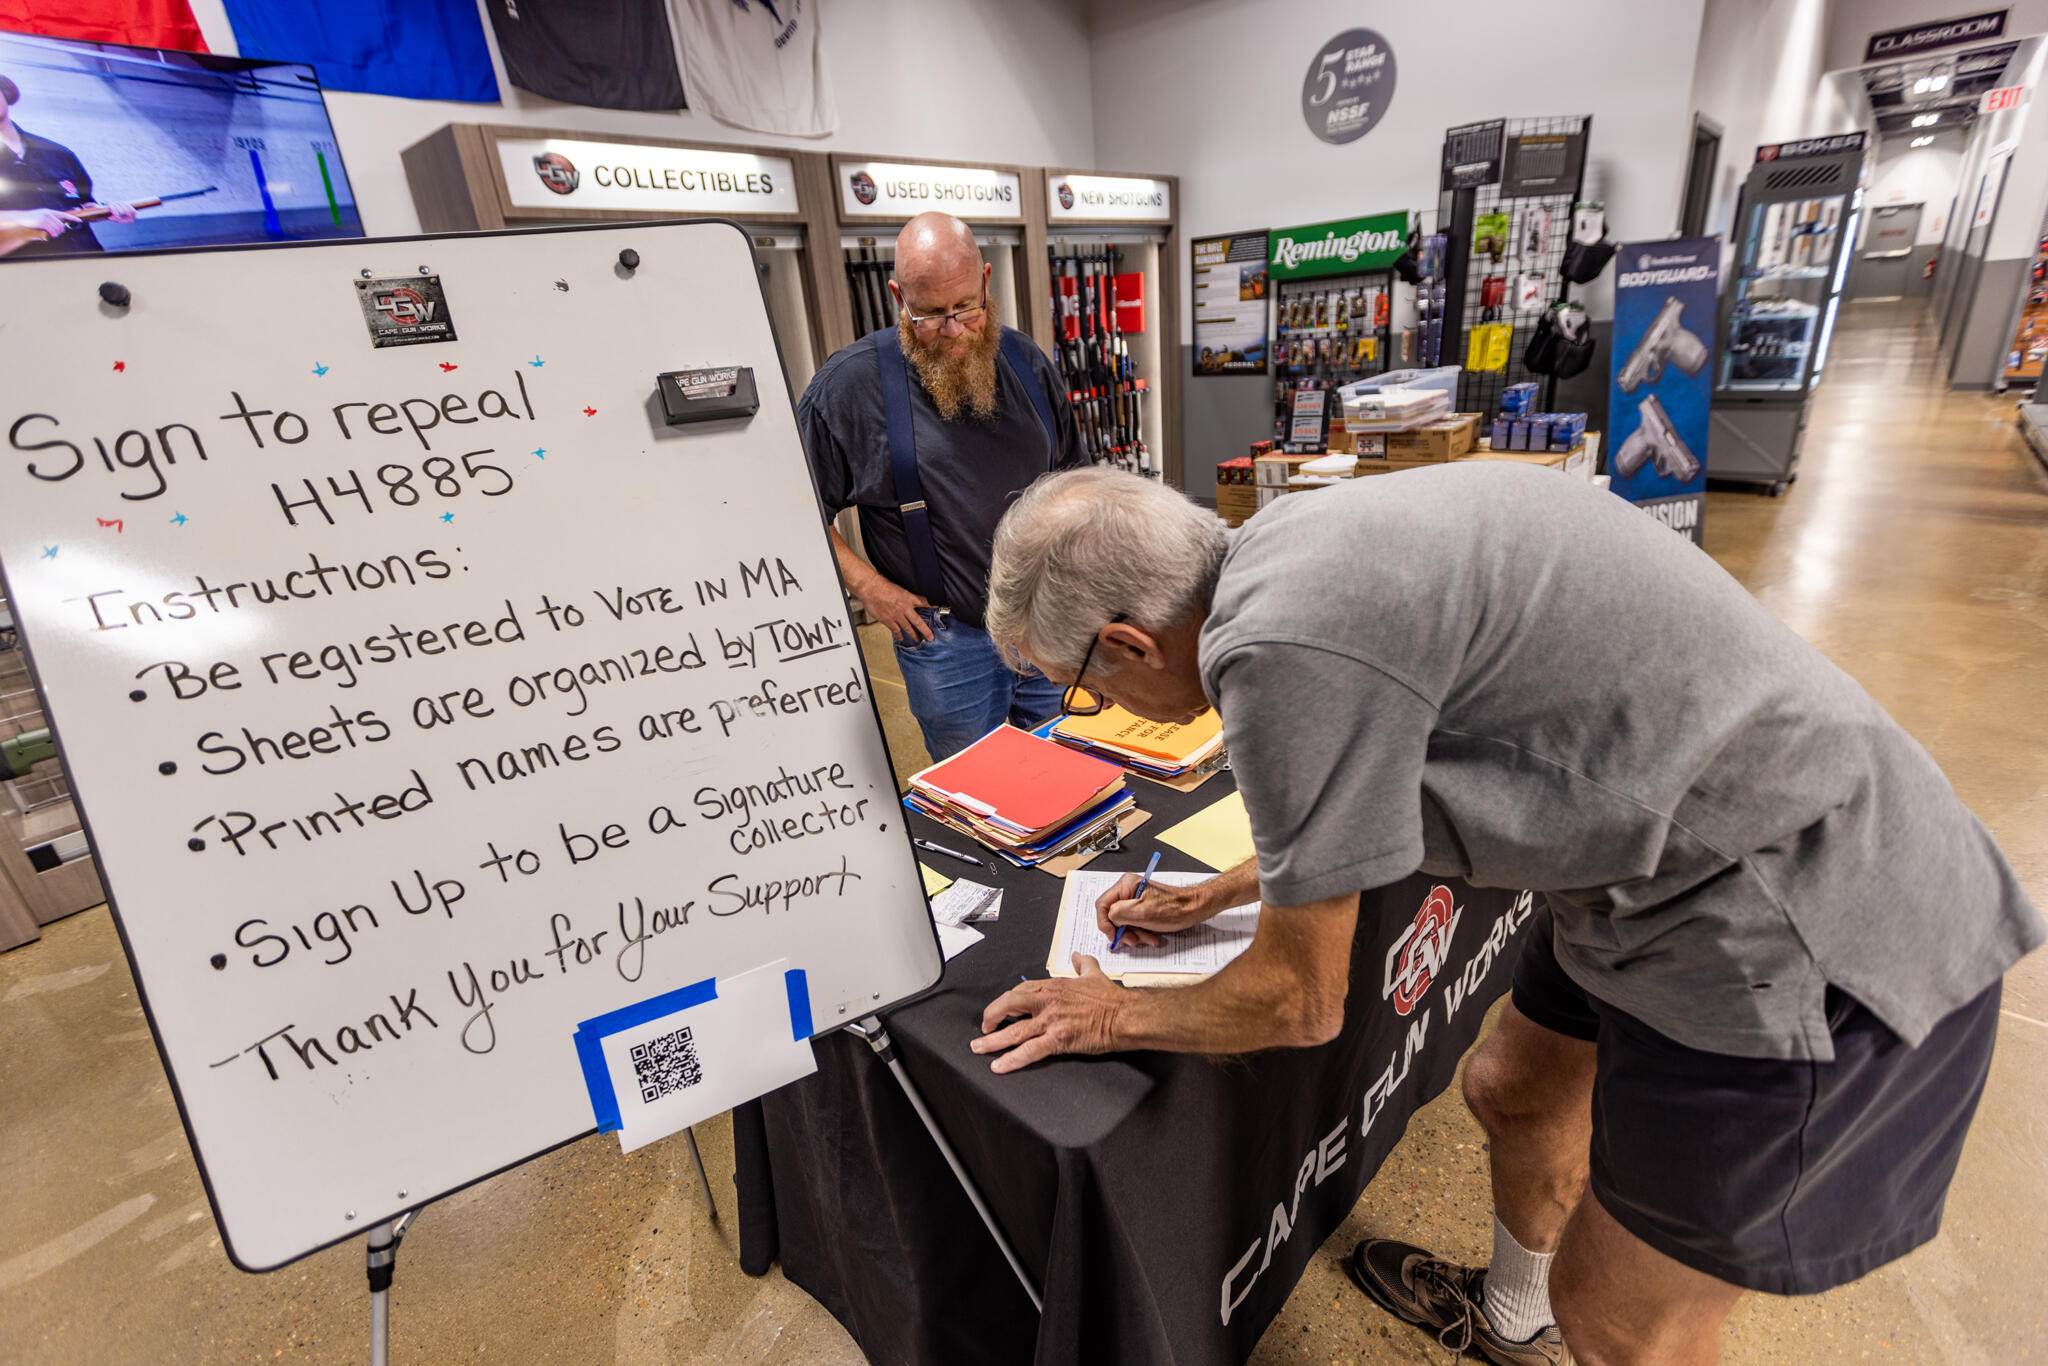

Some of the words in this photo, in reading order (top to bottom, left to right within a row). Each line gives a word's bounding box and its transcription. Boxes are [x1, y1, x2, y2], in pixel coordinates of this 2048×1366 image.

[1874, 16, 1999, 53] CLASSROOM
[1310, 48, 1345, 106] 5
[1986, 87, 2025, 111] EXIT
[594, 165, 773, 194] COLLECTIBLES
[886, 181, 929, 199] USED
[934, 182, 1013, 202] SHOTGUNS
[1081, 191, 1105, 205] NEW
[1108, 191, 1163, 207] SHOTGUNS
[1272, 230, 1401, 269] Remington
[1618, 265, 1710, 288] BODYGUARD
[691, 375, 707, 385] GUN
[709, 371, 737, 382] WORKS
[9, 413, 208, 500] Sign
[220, 391, 309, 449] to
[332, 370, 535, 450] repeal
[271, 449, 514, 526] H4885
[66, 547, 469, 631] Instructions:
[135, 661, 242, 700] Be
[260, 600, 525, 688] registered
[536, 595, 585, 632] to
[695, 577, 728, 606] IN
[739, 557, 802, 598] MA
[197, 705, 391, 775] Sheets
[412, 688, 494, 729] are
[508, 633, 706, 716] organized
[715, 628, 756, 668] by
[1115, 717, 1147, 738] TANCE
[1154, 723, 1180, 741] EASE
[193, 769, 433, 856] Printed
[457, 726, 622, 790] names
[639, 707, 702, 741] are
[709, 667, 862, 737] preferred
[235, 904, 379, 967] Sign
[480, 842, 540, 883] to
[559, 822, 630, 864] be
[648, 805, 687, 834] a
[448, 958, 544, 1054] You
[545, 913, 608, 974] for
[617, 897, 695, 982] Your
[708, 855, 862, 917] Support
[1221, 1116, 1349, 1326] CAPE
[1361, 1008, 1430, 1137] GUN
[1444, 889, 1533, 1024] WORKS
